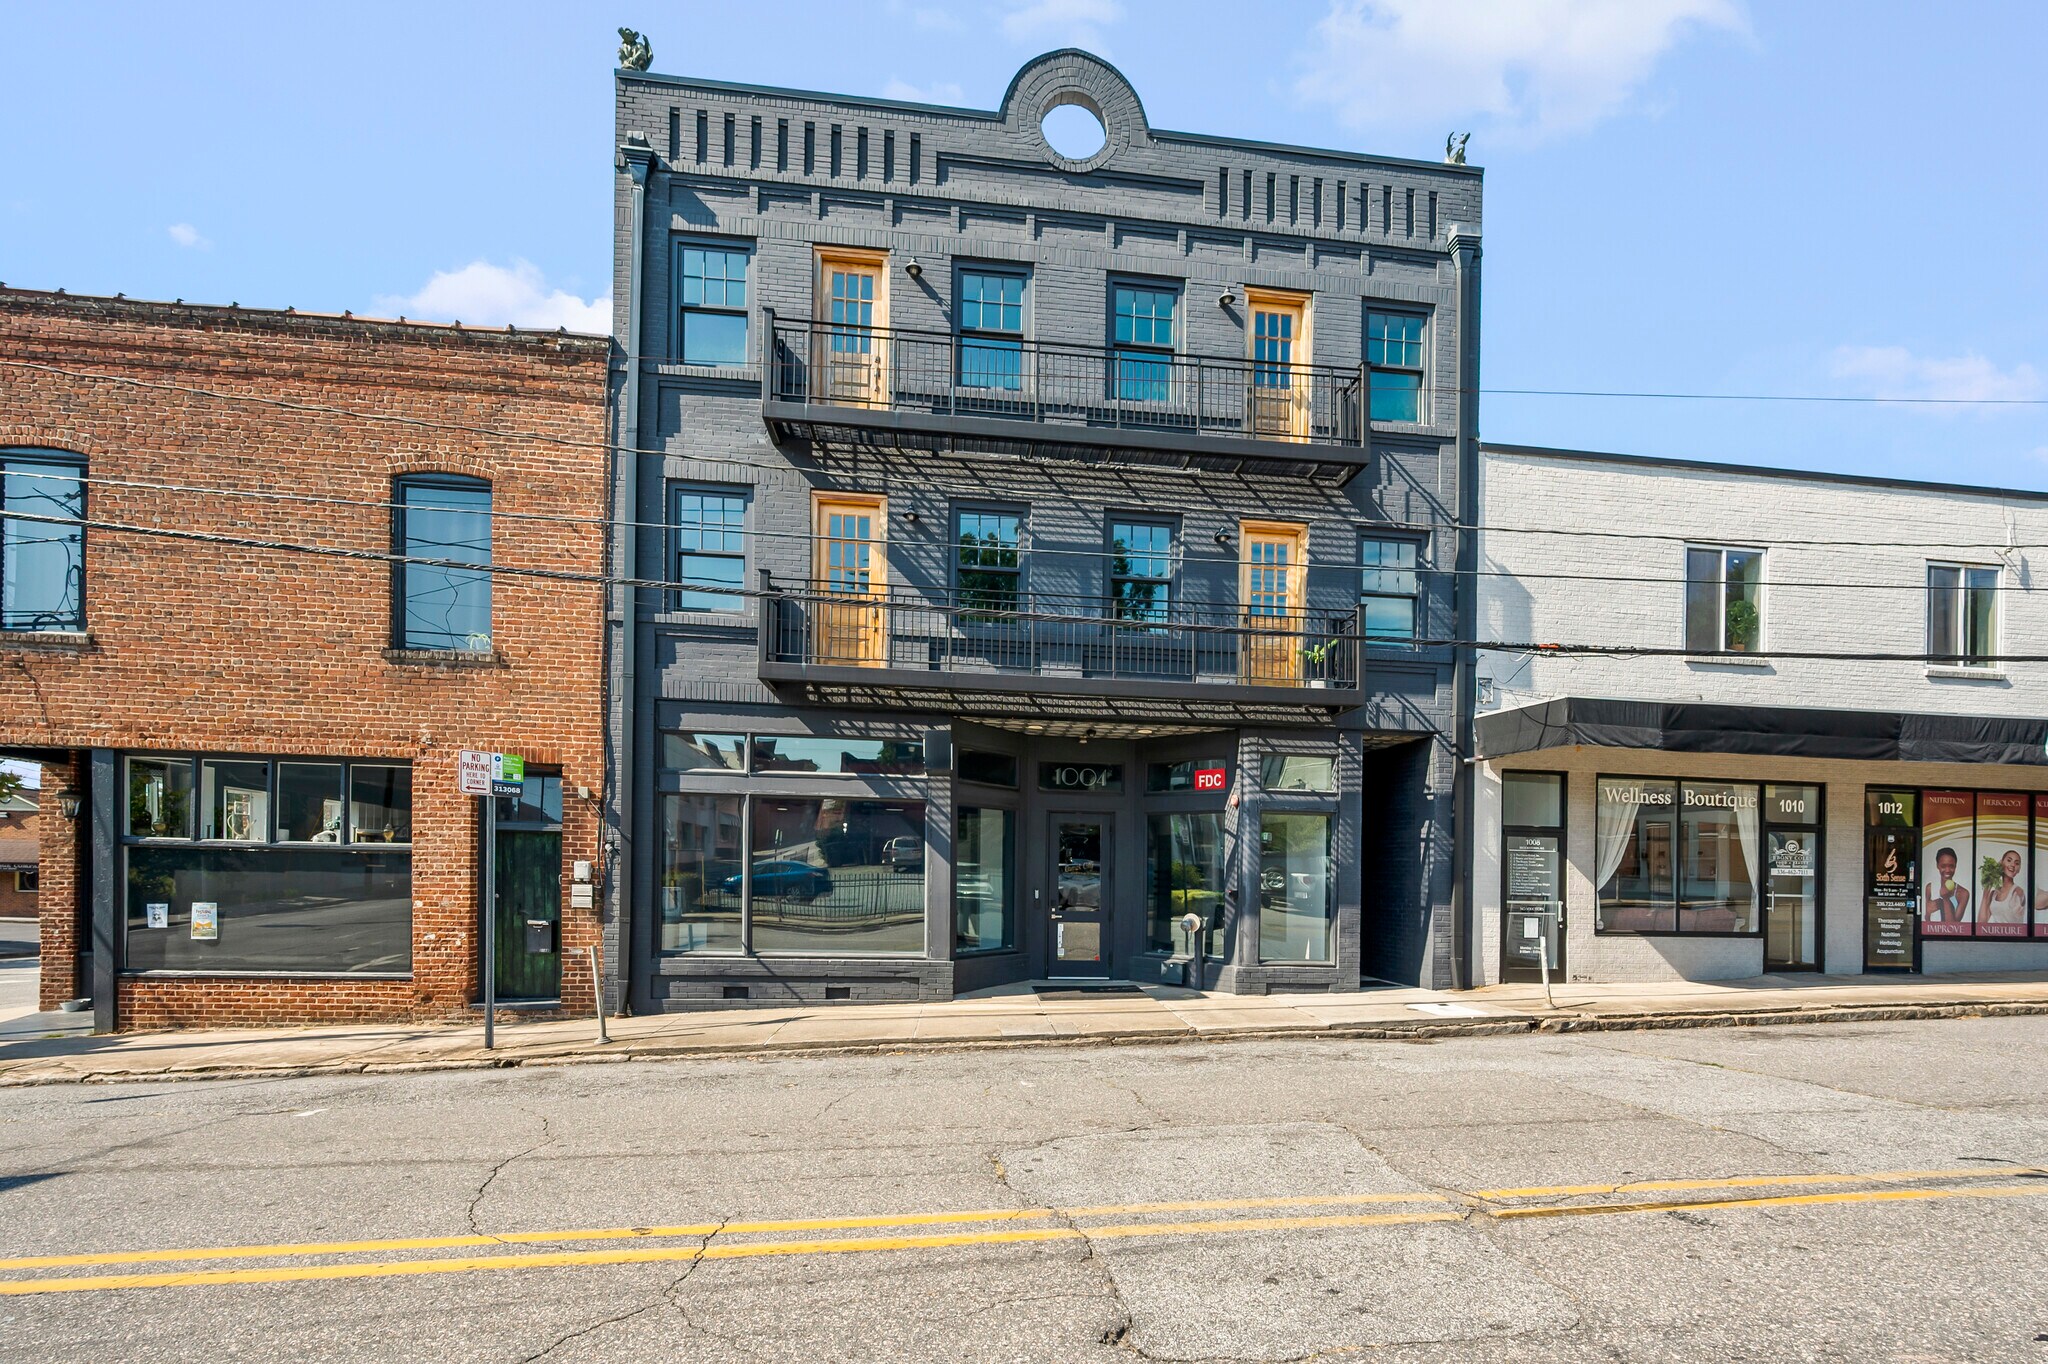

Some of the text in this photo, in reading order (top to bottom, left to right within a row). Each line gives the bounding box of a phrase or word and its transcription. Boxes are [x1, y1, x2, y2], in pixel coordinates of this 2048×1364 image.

[472, 754, 480, 762] NO
[462, 762, 490, 772] PARKING
[1055, 767, 1107, 786] 1004
[1198, 774, 1222, 788] FDC
[1604, 786, 1758, 812] Wellness Boutique
[1929, 796, 1966, 805] NUTRITION
[1983, 798, 2022, 807] HERBOLOGY
[1779, 799, 1805, 814] 1010
[1878, 802, 1903, 814] 1012
[1890, 874, 1906, 882] Sense
[1927, 924, 1964, 934] IMPROVE
[1981, 926, 2022, 935] NURTURE
